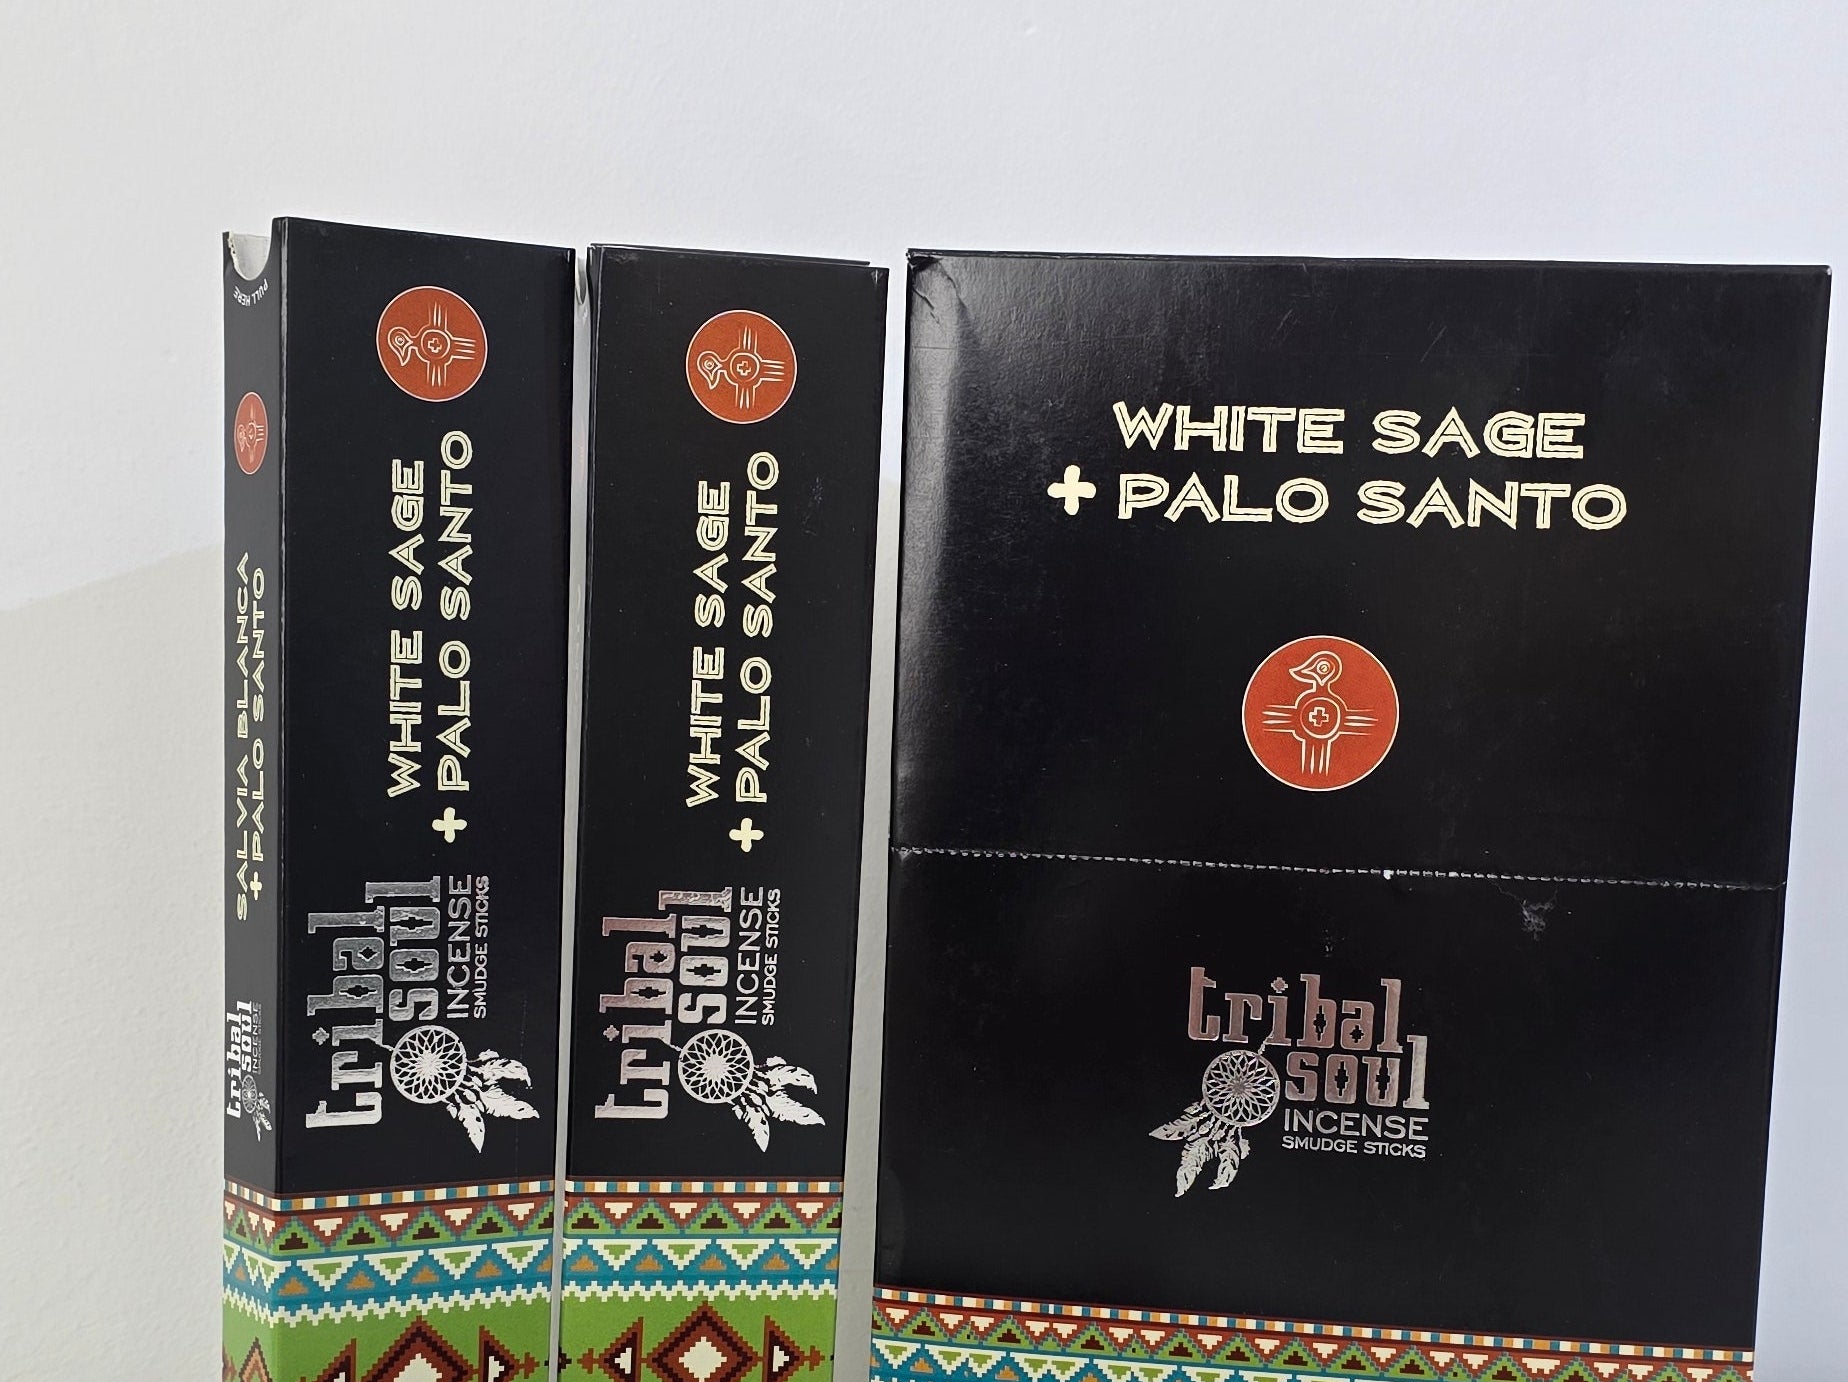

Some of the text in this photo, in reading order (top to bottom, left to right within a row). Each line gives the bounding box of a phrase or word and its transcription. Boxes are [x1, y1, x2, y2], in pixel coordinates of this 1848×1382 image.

[252, 279, 268, 304] PULL
[1113, 401, 1585, 459] WHITE SAGE
[438, 431, 473, 620] SANTO
[741, 452, 779, 637] SANTO
[1118, 472, 1329, 523] PALO
[1357, 477, 1627, 530] SANTO
[252, 568, 264, 721] SANTO
[387, 459, 424, 797] WHITE SAGE
[686, 481, 730, 807] WHITE SAGE
[237, 552, 248, 920] SALVIA BLANCA
[436, 641, 471, 791] PALO
[735, 657, 772, 802] PALO
[252, 738, 264, 861] PALO
[365, 876, 440, 1021] soul
[447, 875, 471, 1018] INCENSE
[474, 876, 489, 1019] SMUDGE STICKS
[595, 914, 677, 1119] tribal
[658, 887, 732, 1024] soul
[735, 887, 764, 1025] INCENSE
[762, 889, 780, 1025] SMUDGE STICKS
[1187, 967, 1403, 1053] tribal
[226, 1012, 241, 1118] tribal
[236, 1001, 252, 1072] soul
[306, 906, 385, 1128] tribal
[1284, 1035, 1430, 1109] soul
[1282, 1135, 1426, 1158] SMUDGE STICKS
[1284, 1109, 1429, 1141] INCENSE
